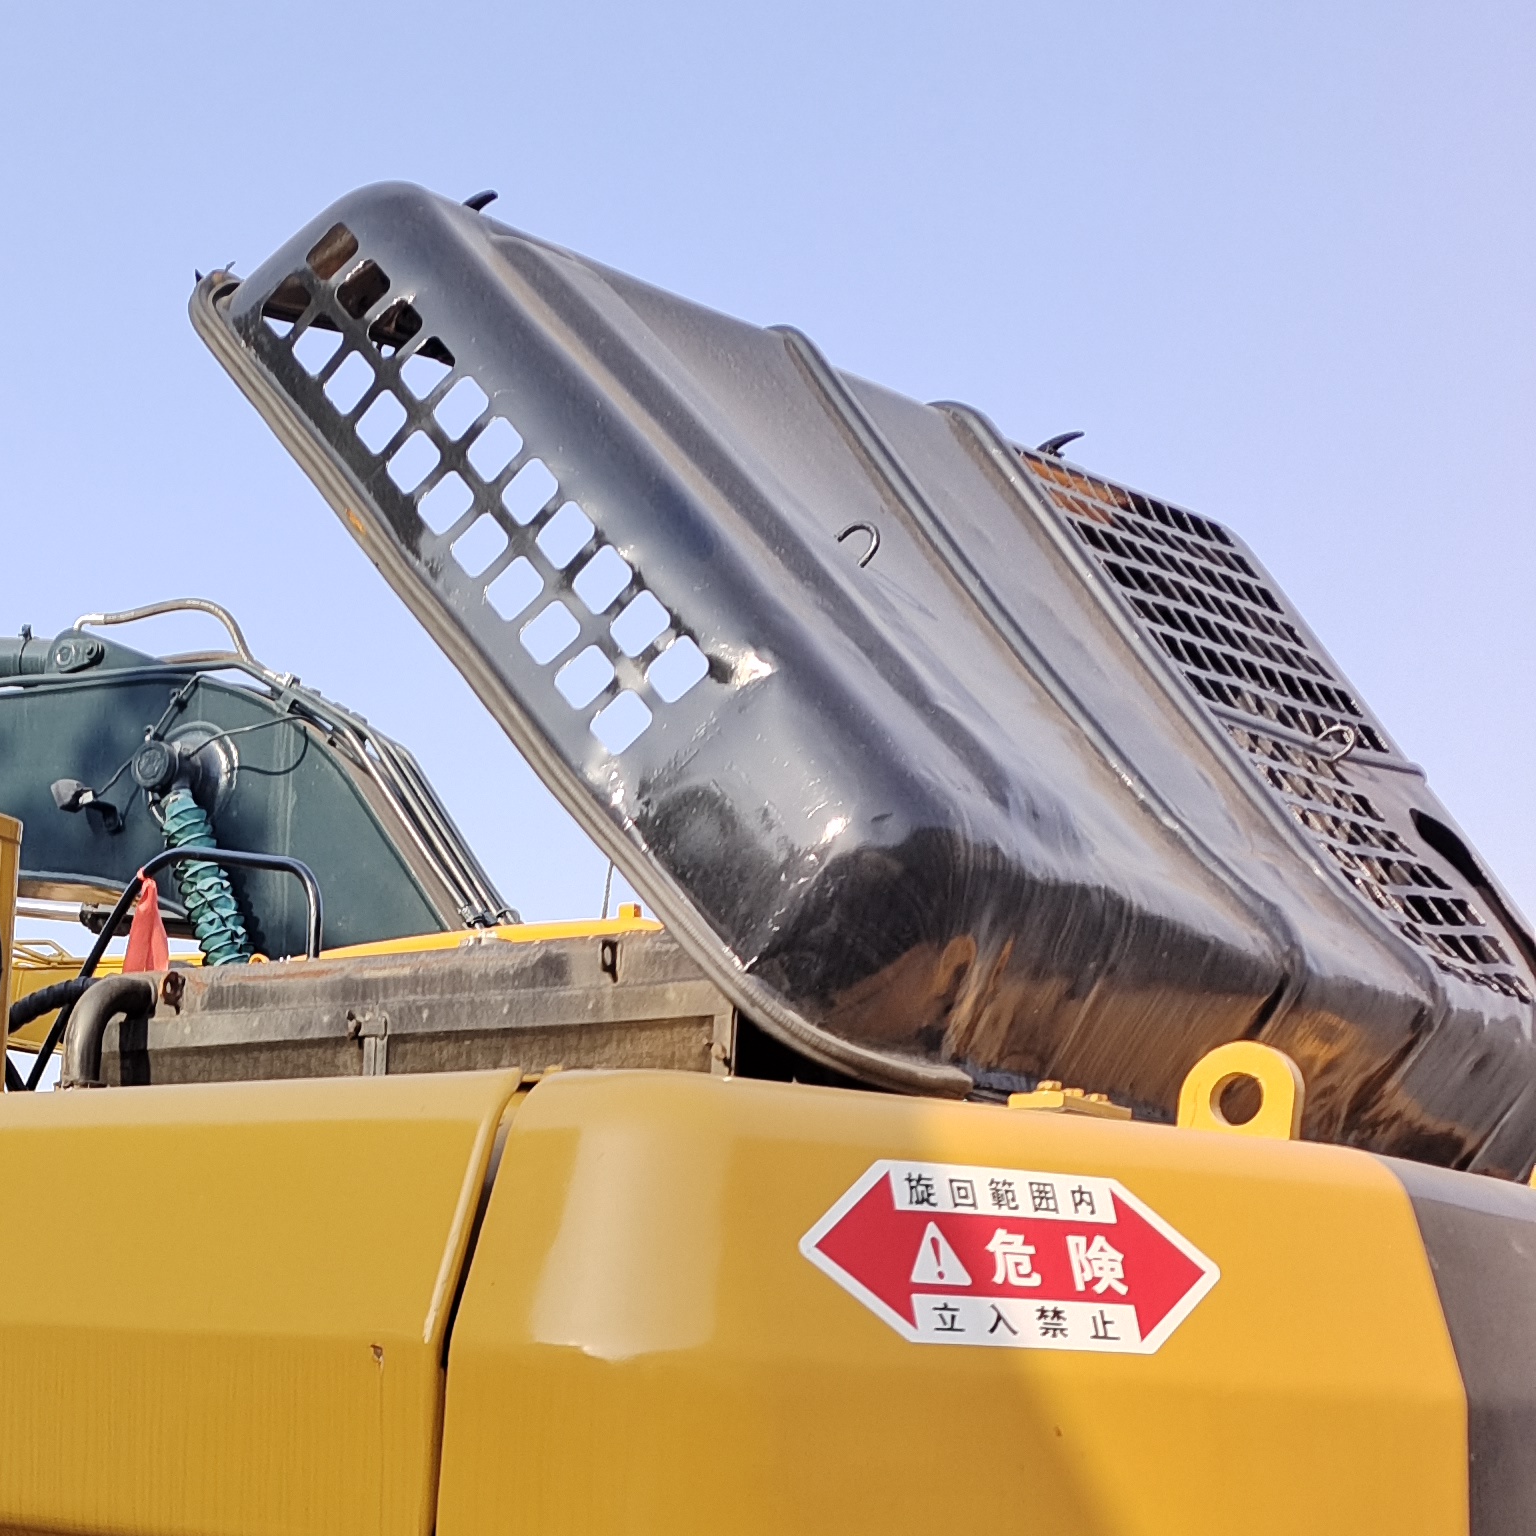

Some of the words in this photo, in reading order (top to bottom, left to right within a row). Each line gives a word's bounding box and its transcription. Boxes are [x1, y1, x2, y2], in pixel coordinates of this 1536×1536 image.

[904, 1172, 1097, 1216] 旋回範囲内
[985, 1227, 1130, 1296] 危険
[932, 1301, 1122, 1342] 立入禁止
